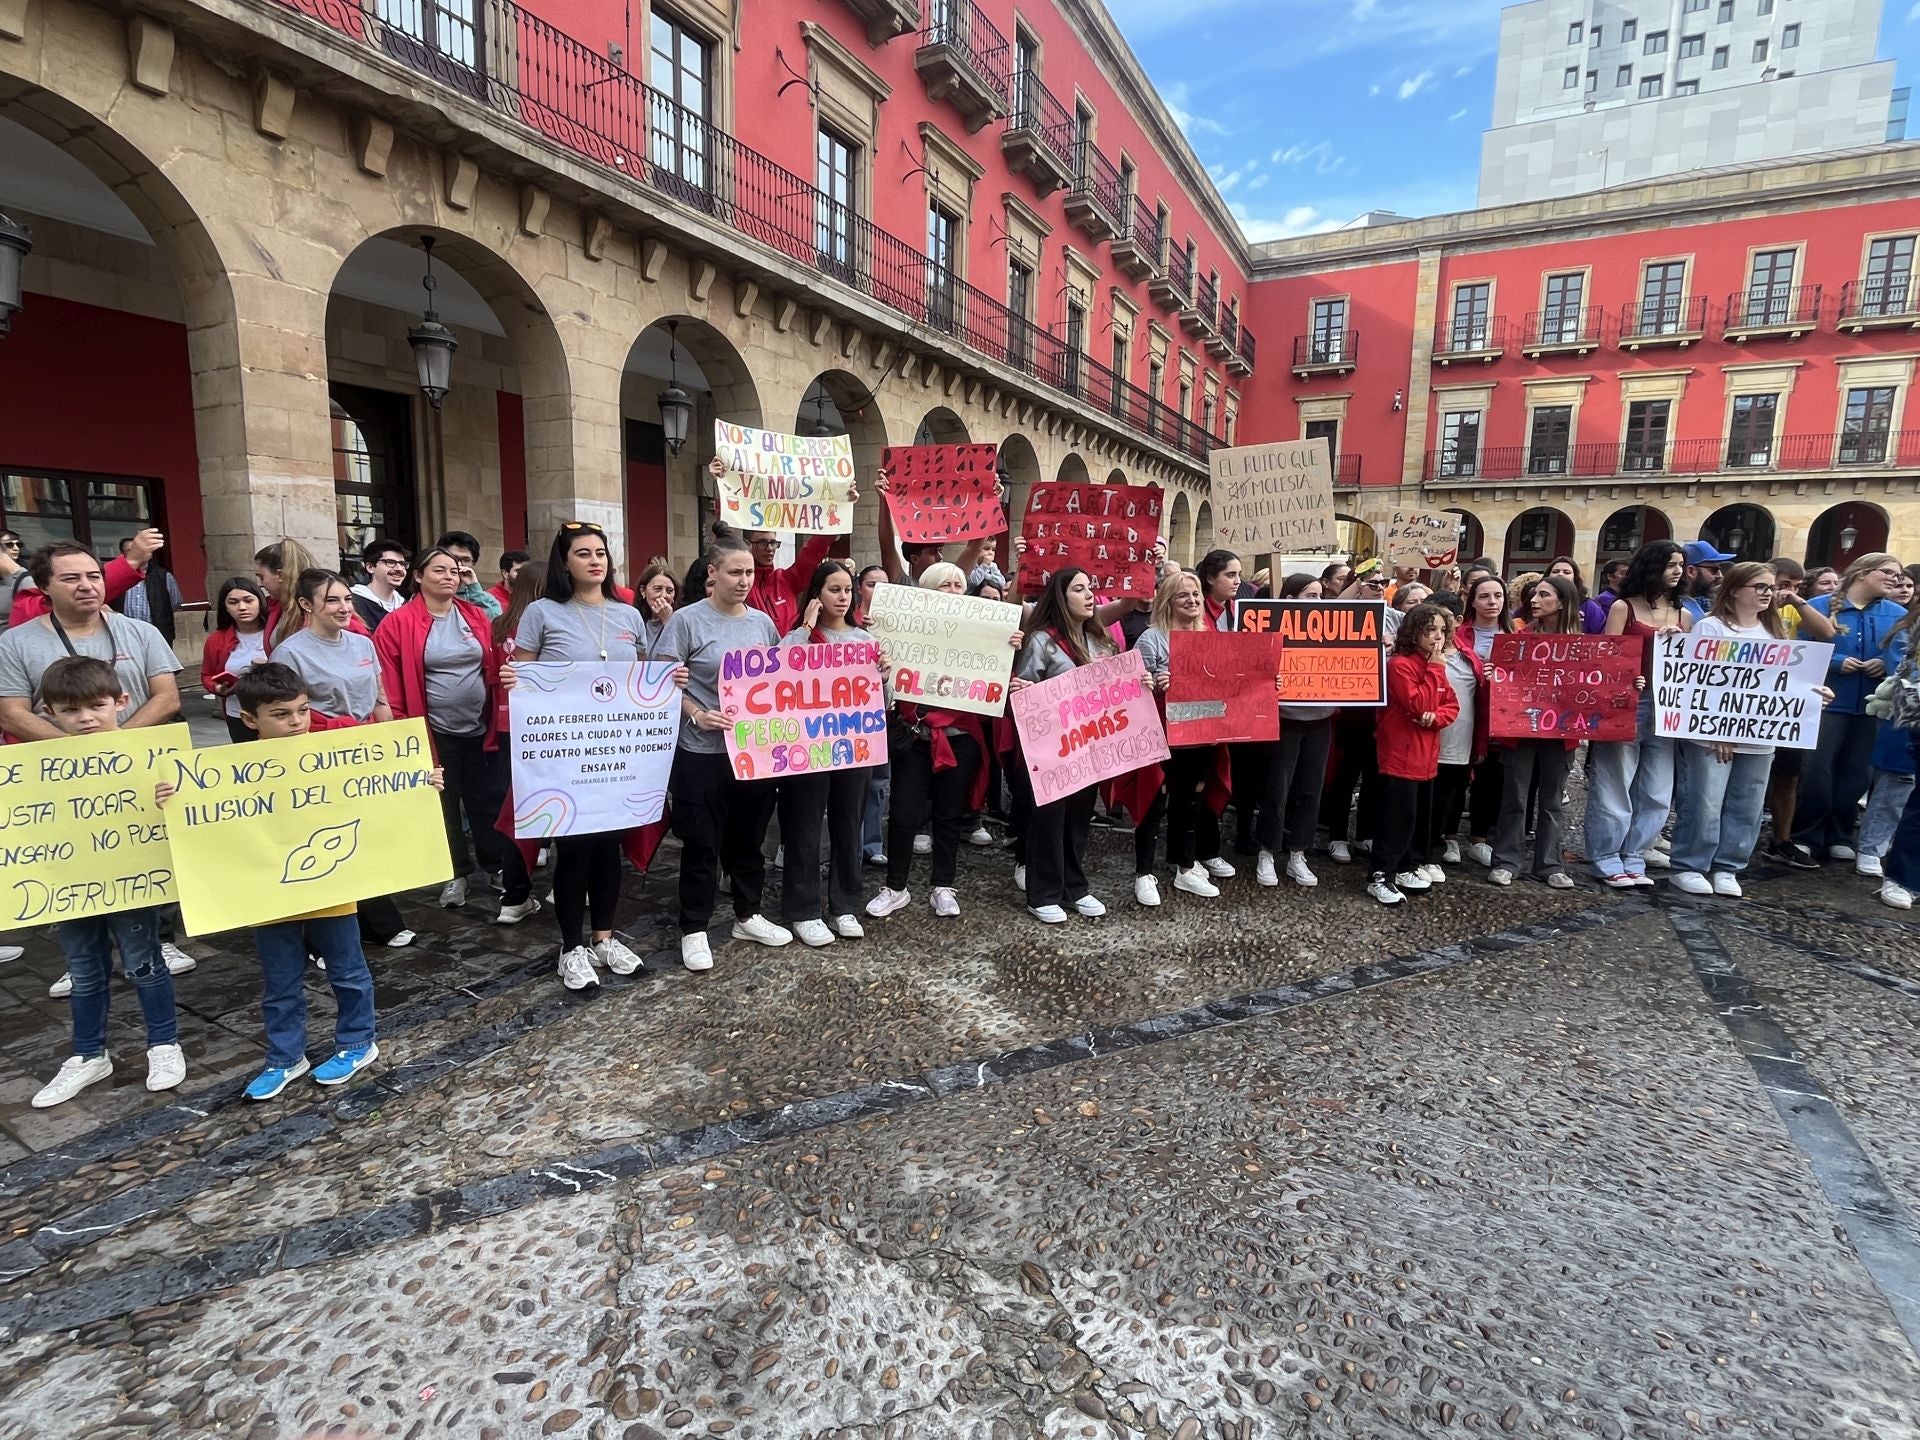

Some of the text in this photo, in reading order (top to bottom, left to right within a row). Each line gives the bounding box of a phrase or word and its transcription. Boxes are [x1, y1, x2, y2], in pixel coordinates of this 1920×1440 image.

[718, 421, 850, 457] NOS QUIEREN
[718, 445, 852, 477] CALLAR PERO
[1219, 449, 1319, 477] EL RUIDO QUE
[739, 474, 835, 500] VAMOS A
[750, 501, 823, 530] SONAR
[1223, 499, 1275, 521] TAMBIÉN
[1229, 529, 1239, 544] A
[872, 586, 1019, 622] ENSAYAR PARA
[872, 610, 958, 638] SONAR Y
[1243, 609, 1377, 642] SE ALQUILA
[723, 641, 880, 681] NOS QUIEREN
[879, 636, 998, 671] ONAR PARA
[1280, 651, 1376, 672] INSTRUMENTO
[1662, 636, 1807, 666] 14 CHARANGAS
[895, 667, 1003, 703] ALEGRAR
[1013, 652, 1137, 717] EL ANTROXU
[1321, 676, 1373, 690] MOLESTA
[1664, 661, 1789, 692] DISPUESTAS A
[745, 675, 871, 715] CALLAR
[1026, 678, 1142, 742] ES PASIÓN
[1658, 687, 1806, 718] QUE EL ANTROXU
[527, 711, 669, 725] CADA FEBRERO LLENANDO DE
[735, 709, 886, 750] PERO VAMOS
[1058, 708, 1129, 757] JAMÁS
[1664, 711, 1801, 741] NO DESAPAREZCA
[521, 727, 673, 743] COLORES LA CIUDAD Y A MENOS
[41, 751, 133, 782] PEQUEÑO
[174, 735, 420, 792] NO NOS QUITÉIS LA
[522, 743, 672, 760] DE CUATRO MESES NO PODEMOS
[735, 738, 870, 779] A SONAR
[1041, 726, 1168, 796] PROHIBICIÓN
[581, 762, 626, 773] ENSAYAR
[68, 789, 145, 819] TOCAR.
[184, 769, 434, 826] ILUSIÓN DEL CARNAVAL
[91, 828, 120, 852] NO
[12, 869, 172, 921] DISFRUTAR
